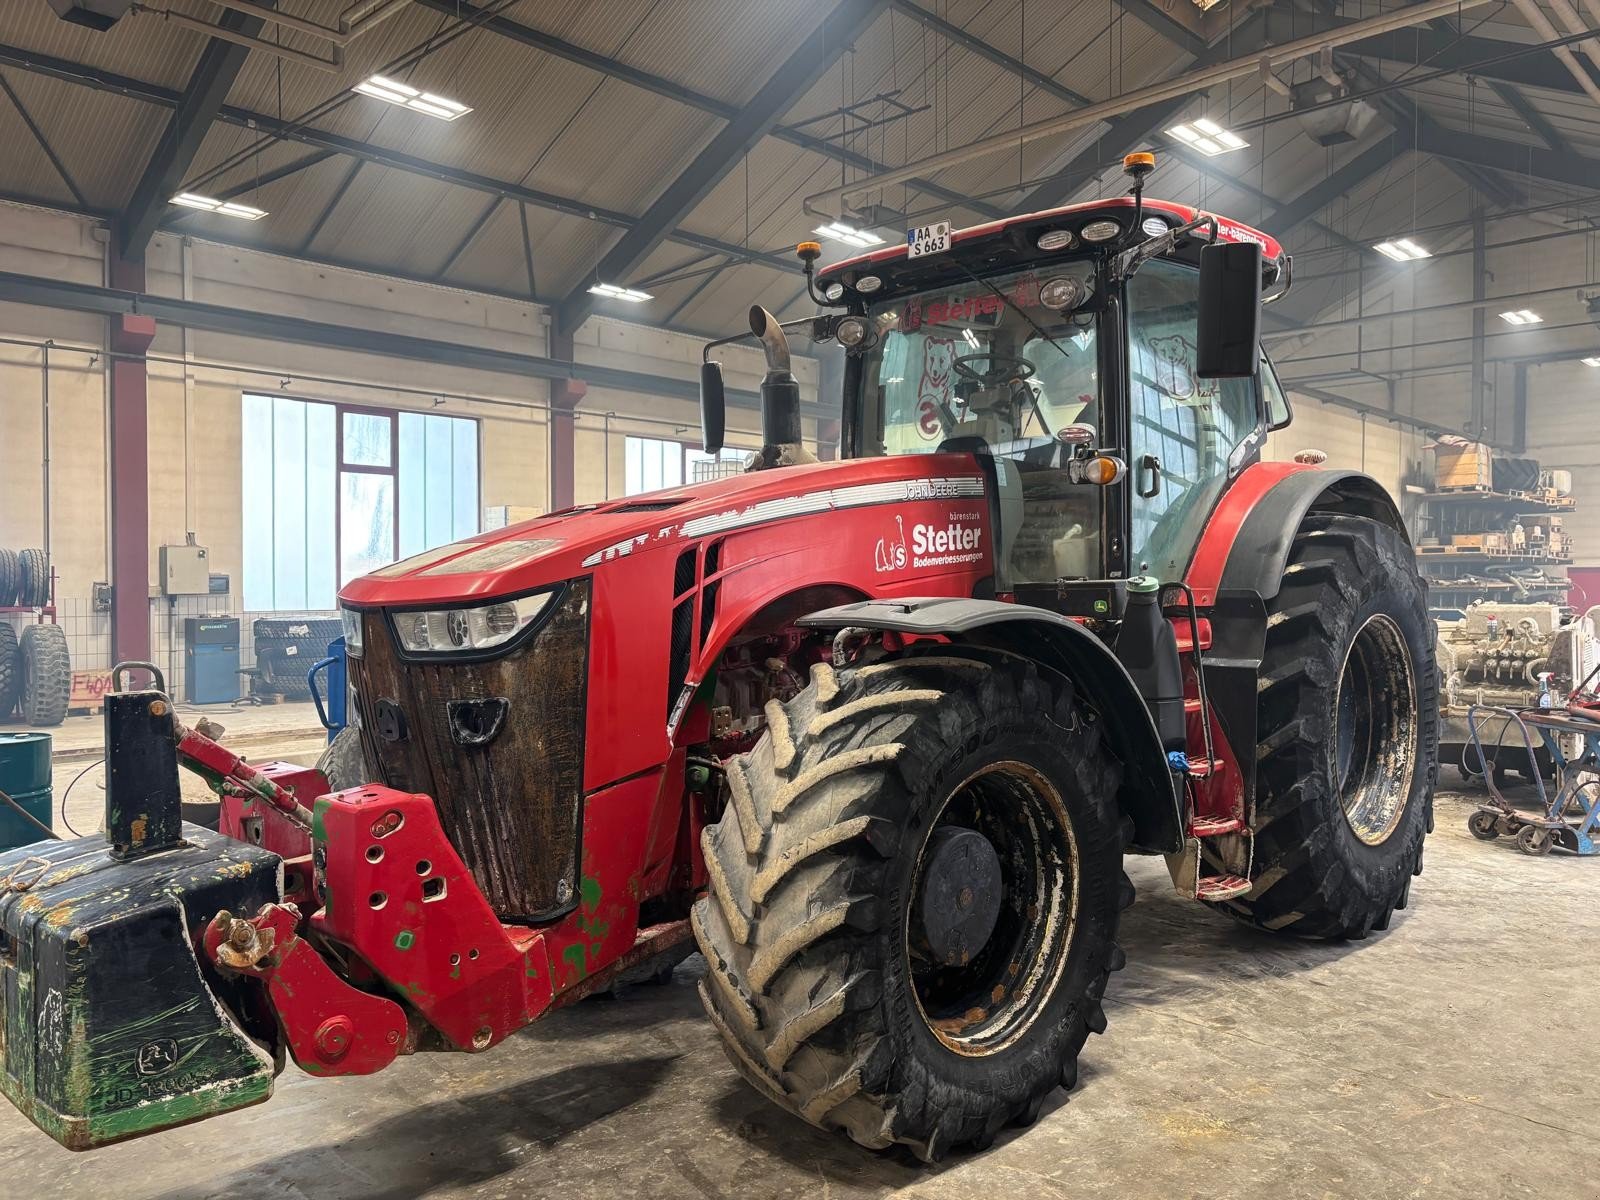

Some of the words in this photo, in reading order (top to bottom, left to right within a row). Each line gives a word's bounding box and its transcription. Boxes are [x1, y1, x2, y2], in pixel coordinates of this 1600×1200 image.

[918, 227, 930, 241] AA
[914, 243, 921, 255] S
[924, 237, 944, 253] 663
[902, 484, 929, 499] JOHN
[929, 482, 959, 497] DEERE
[949, 512, 980, 521] bärenstark
[912, 523, 981, 555] Stetter
[913, 552, 983, 568] Bodenverbesserungen
